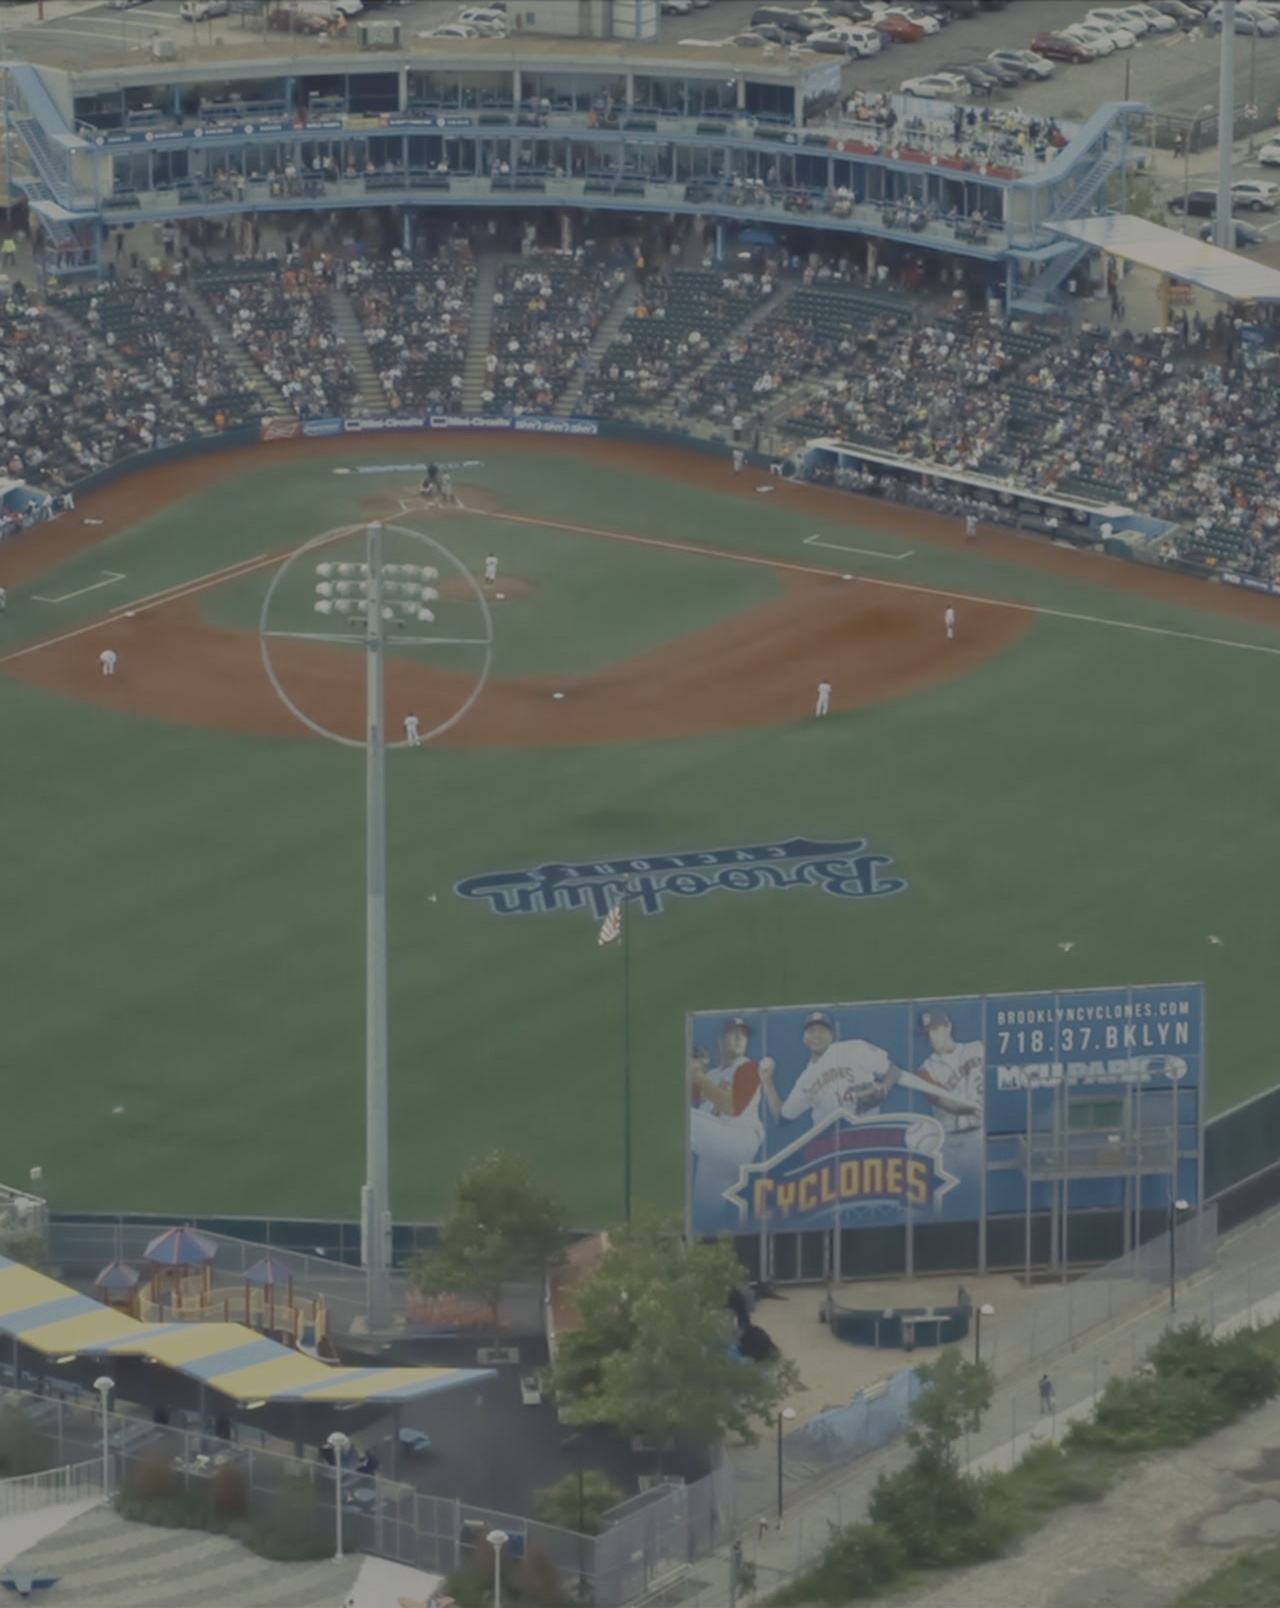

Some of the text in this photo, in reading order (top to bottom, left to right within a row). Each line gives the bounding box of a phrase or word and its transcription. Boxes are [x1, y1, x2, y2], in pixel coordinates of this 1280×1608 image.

[472, 853, 909, 920] Brooklyn
[996, 1001, 1190, 1026] BROOKLYNCYCLONES.COM
[997, 1021, 1189, 1055] 718.37.BKLYN
[996, 1062, 1063, 1091] MCU
[1066, 1058, 1153, 1086] PARK
[752, 1156, 929, 1218] CYCLONES
